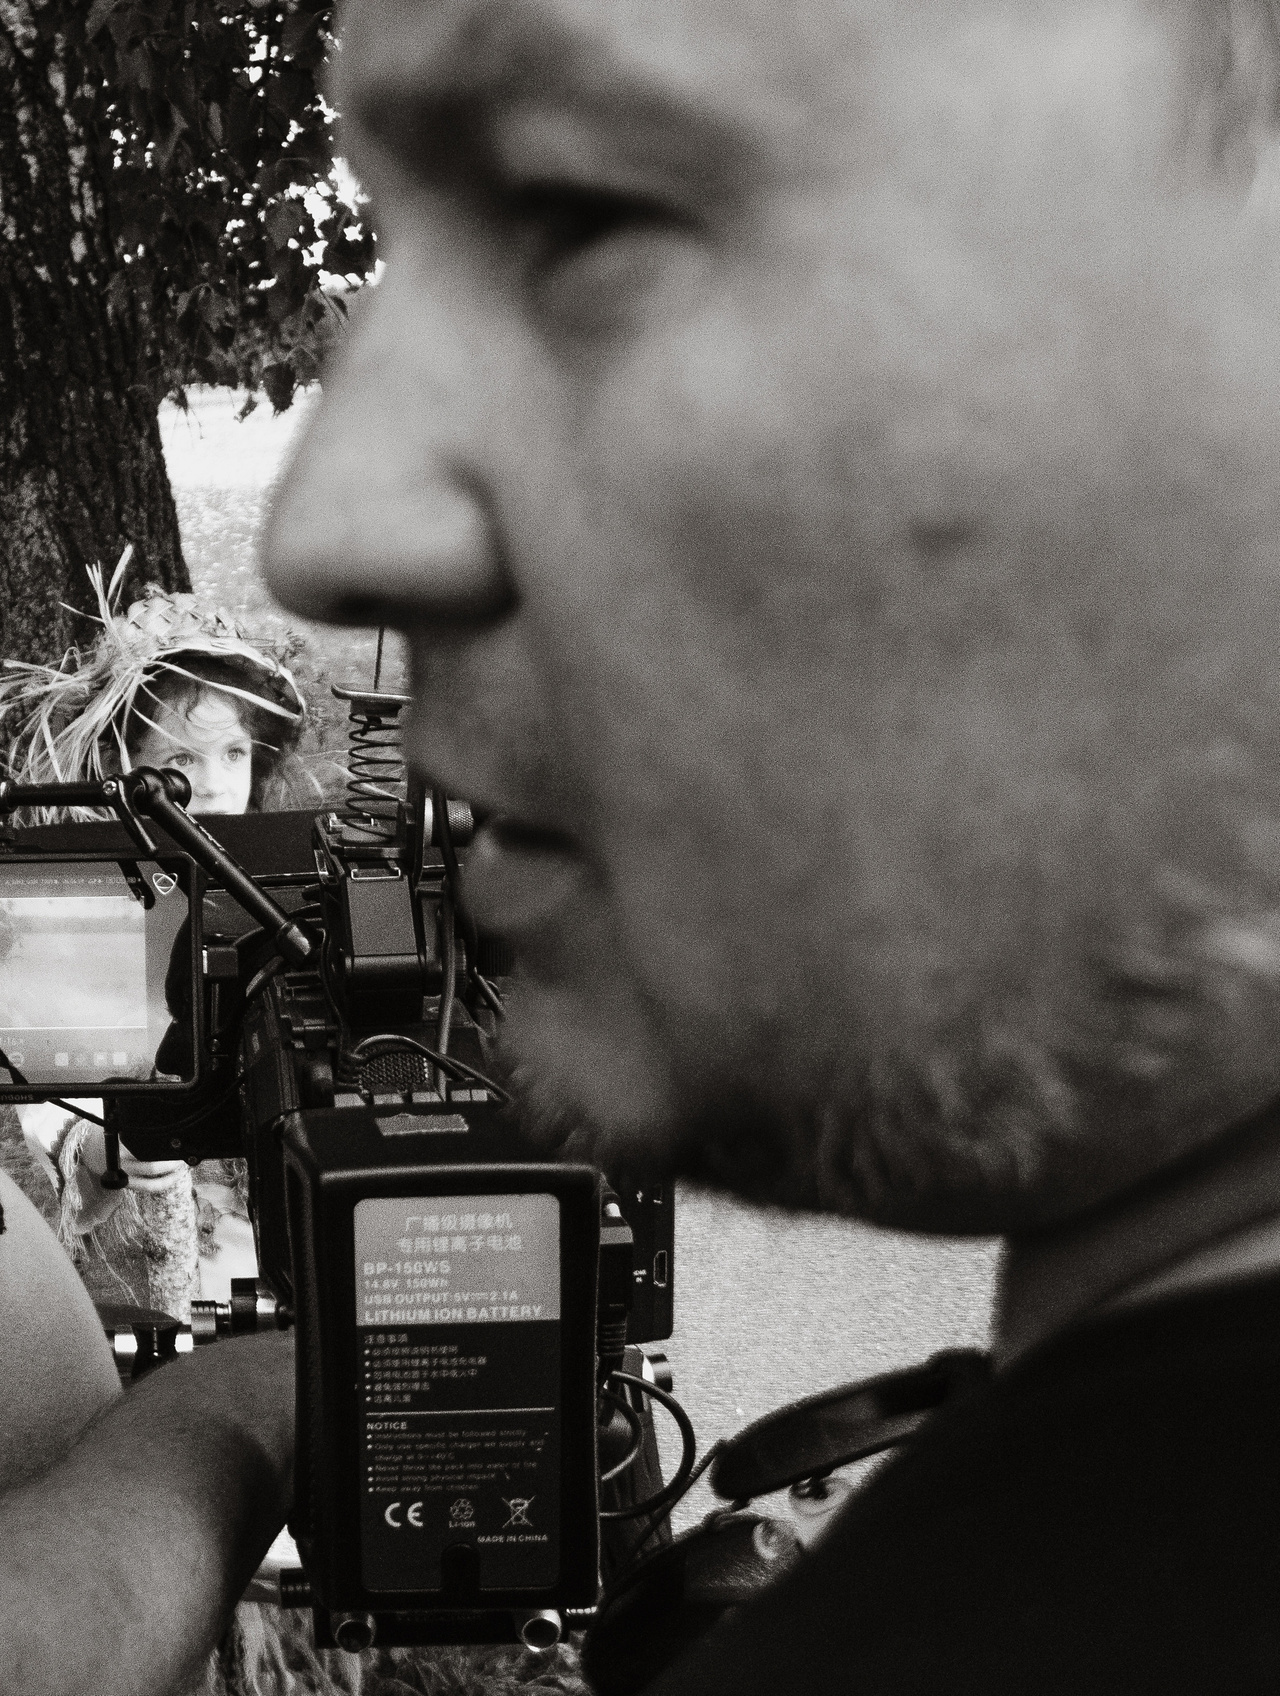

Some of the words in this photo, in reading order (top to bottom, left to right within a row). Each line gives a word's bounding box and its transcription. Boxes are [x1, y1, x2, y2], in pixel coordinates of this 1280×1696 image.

[363, 1260, 451, 1275] BP-150WS
[364, 1294, 391, 1305] USB
[365, 1309, 431, 1323] LITHIUM
[434, 1308, 463, 1321] ION
[466, 1304, 543, 1320] BATTERY
[367, 1421, 407, 1430] NOTICE
[384, 1501, 424, 1528] CE
[477, 1535, 504, 1543] MADE
[506, 1534, 517, 1543] IN
[519, 1534, 548, 1542] CHINA
